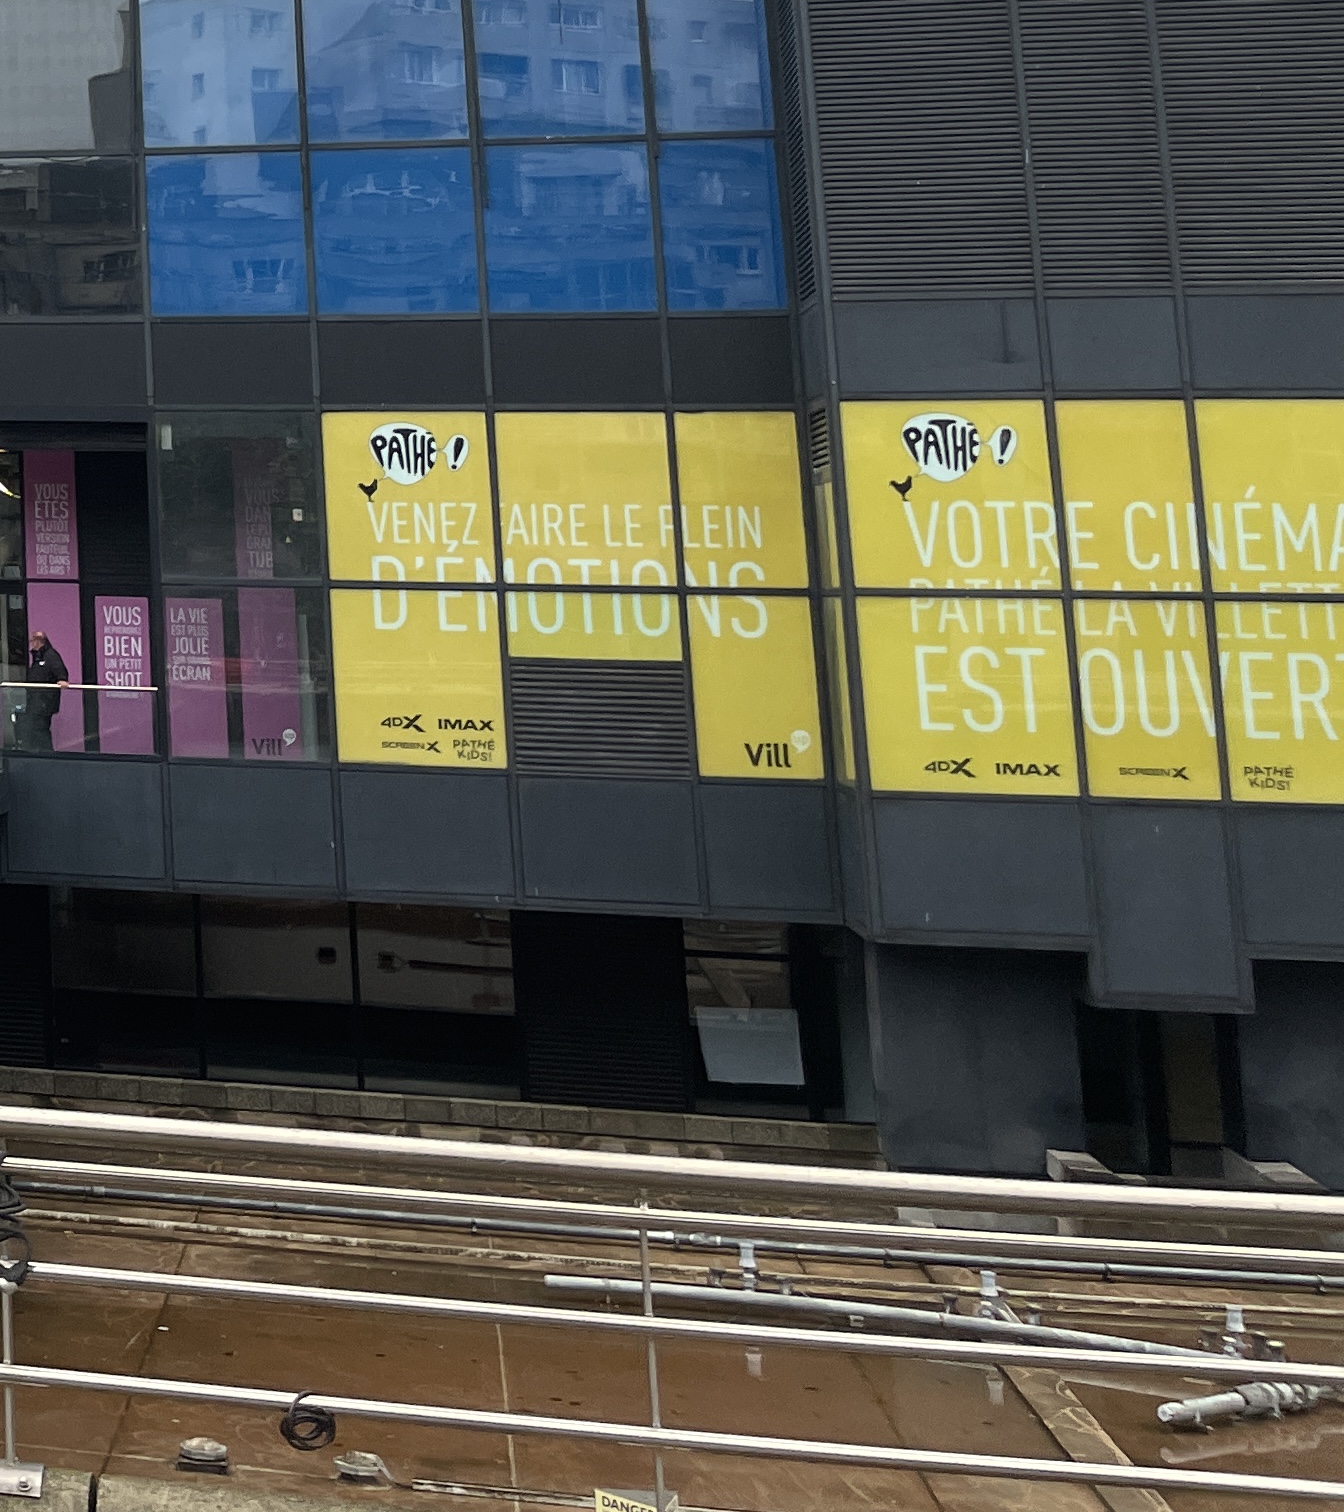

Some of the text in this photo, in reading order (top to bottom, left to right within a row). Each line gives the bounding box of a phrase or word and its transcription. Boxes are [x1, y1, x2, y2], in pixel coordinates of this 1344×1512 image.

[34, 484, 69, 500] VOUS
[367, 502, 479, 545] VENEZ
[499, 503, 589, 547] AIRE
[603, 504, 643, 547] LE
[903, 500, 1099, 570] VOTRE
[909, 566, 1057, 636] PATHÉ
[1074, 580, 1137, 637] LA
[103, 605, 141, 625] VOUS
[170, 607, 208, 623] LA VIE
[104, 636, 142, 657] BIEN
[172, 637, 209, 654] JOLIE
[105, 671, 143, 686] SHOT
[914, 646, 1344, 741] EST OUVER
[437, 718, 495, 731] IMAX
[744, 742, 792, 768] Vill
[995, 762, 1061, 777] IMAX
